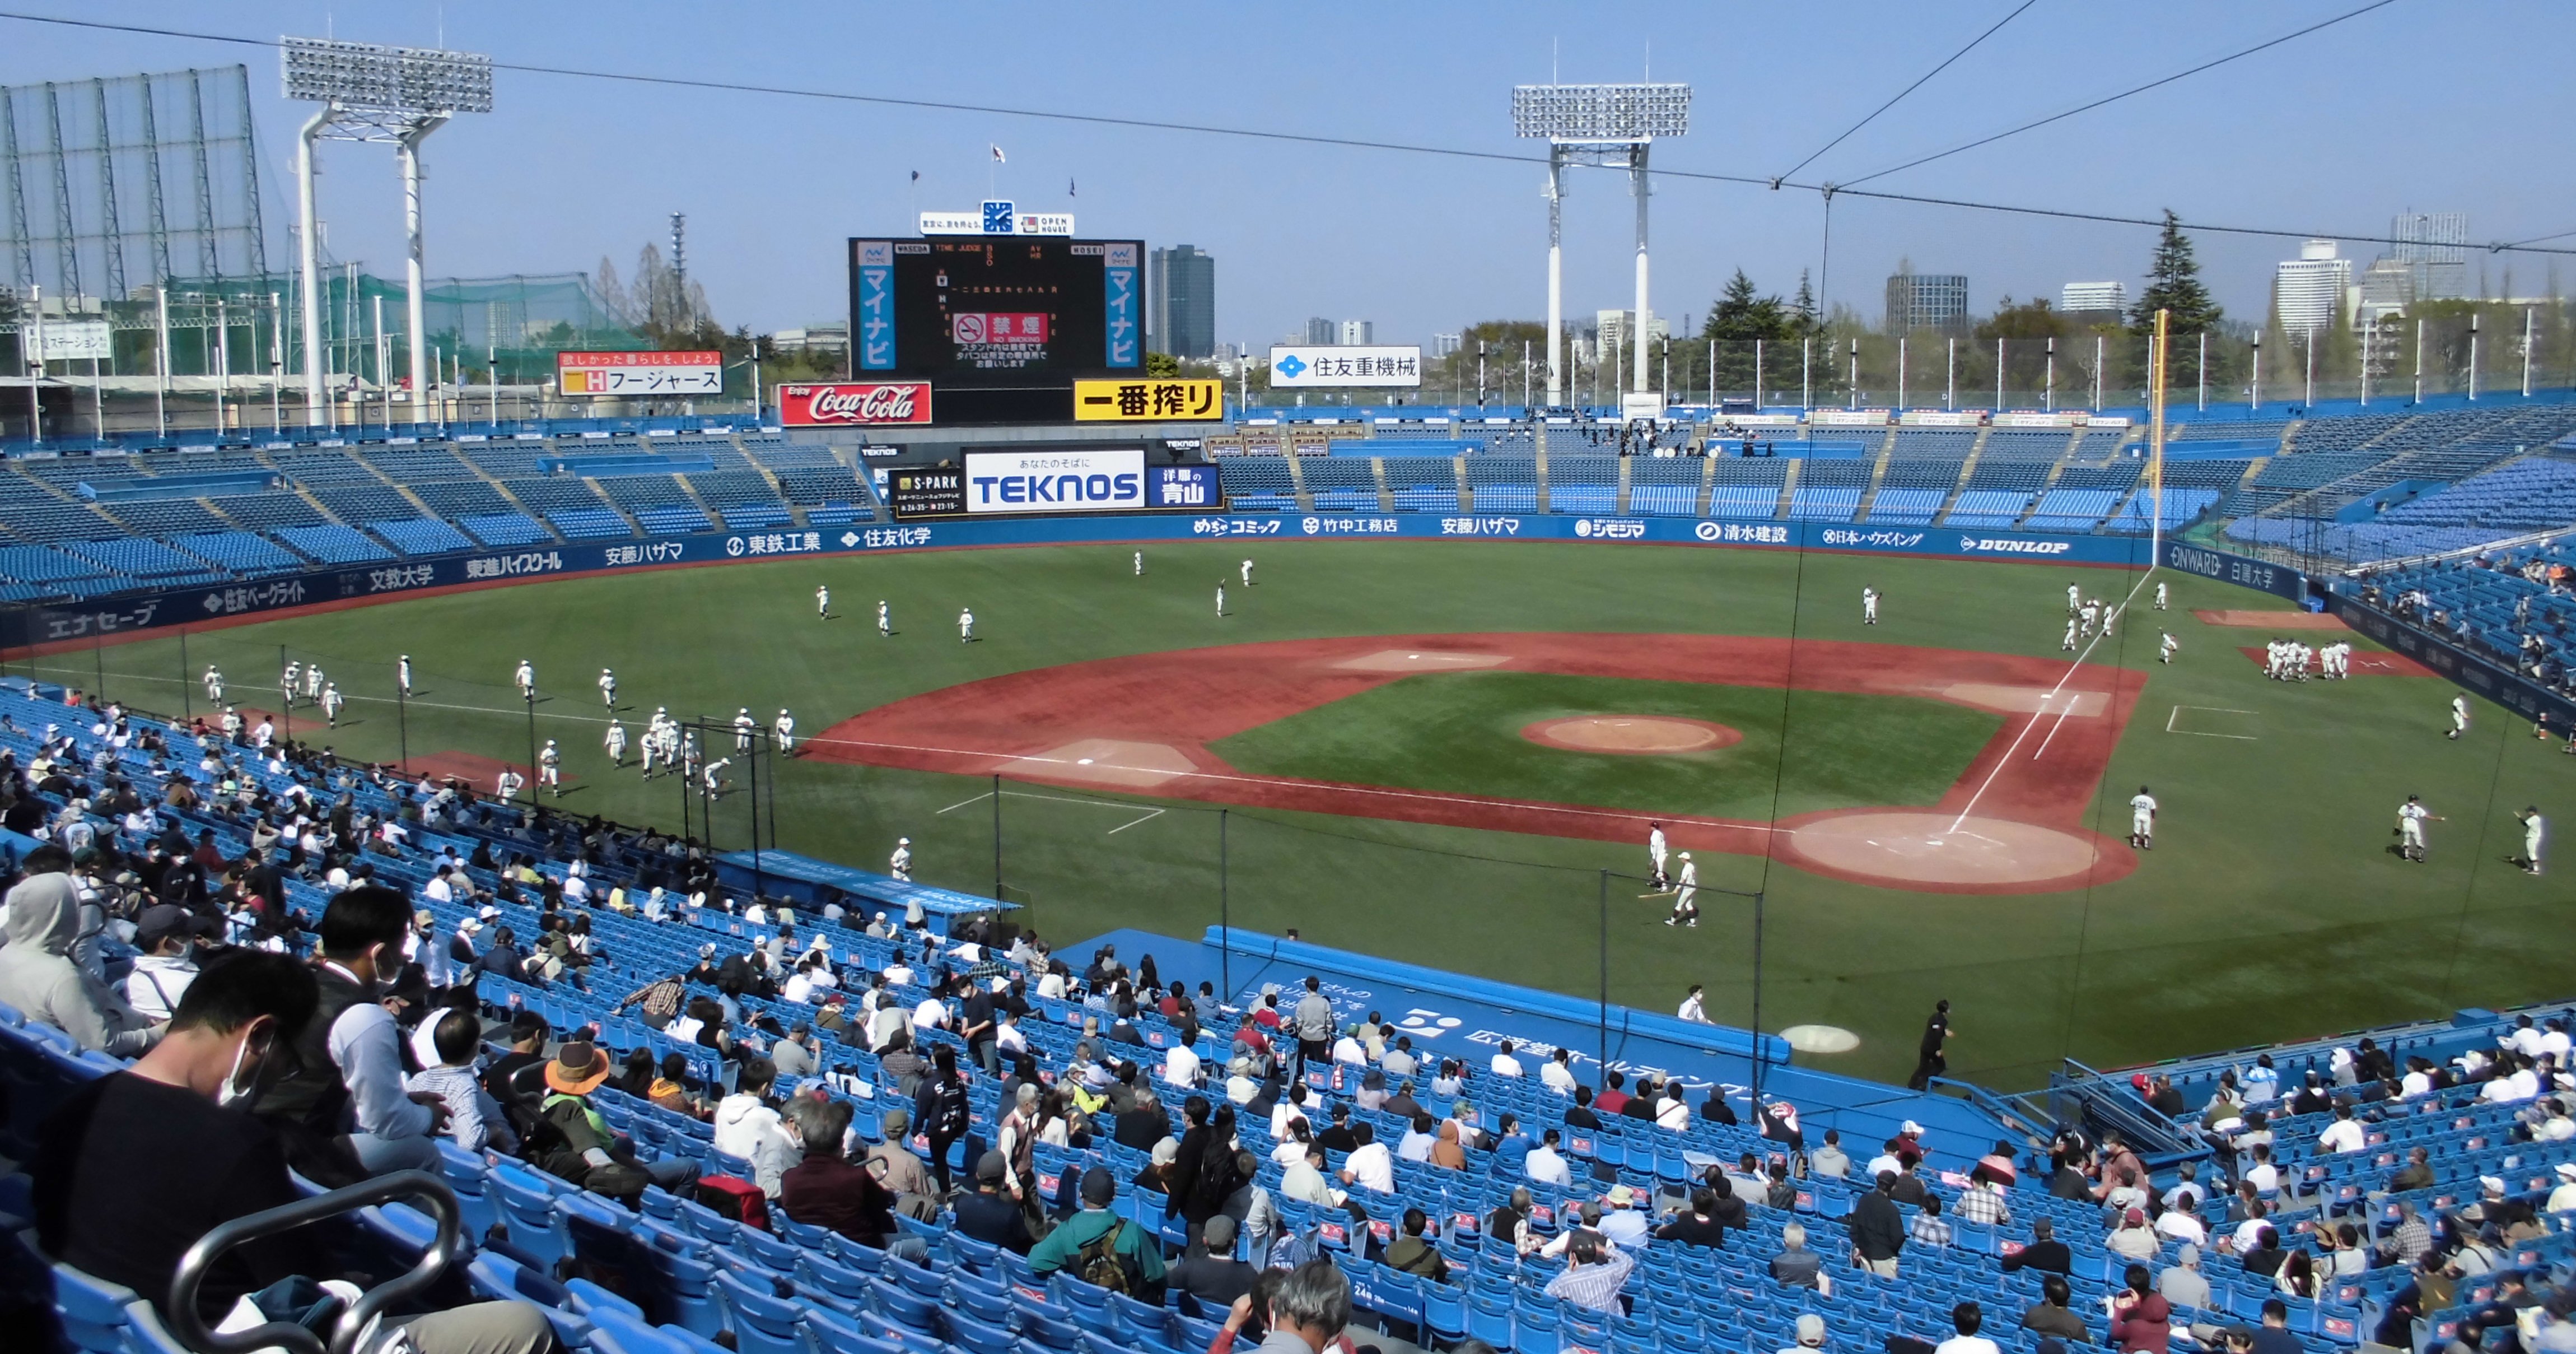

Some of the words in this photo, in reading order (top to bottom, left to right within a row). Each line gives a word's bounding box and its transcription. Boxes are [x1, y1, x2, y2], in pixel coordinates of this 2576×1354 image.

[864, 269, 889, 365] マイナビ
[1110, 271, 1133, 362] マイナビ
[563, 354, 718, 364] 欲しかった暮らしを、しよう。
[1313, 357, 1416, 377] 住友重機械
[610, 370, 717, 389] フージャース
[788, 387, 810, 396] Enjoy
[1084, 384, 1212, 416] 一番搾り
[1020, 459, 1090, 469] あなたのそばに
[914, 476, 958, 490] S-PARK
[1163, 469, 1201, 481] 洋服の
[973, 473, 1138, 504] TEKNOS
[1162, 483, 1204, 504] 青山
[1323, 519, 1397, 533] 竹中工務店
[1441, 518, 1519, 534] 安藤ハザマ
[1593, 524, 1645, 538] シモジマ
[1724, 524, 1787, 543] 清水建設
[749, 532, 822, 554] 東鉄工業
[864, 527, 931, 547] 住友化学
[1836, 531, 1923, 547] 日本ハウズイング
[1977, 538, 2069, 553] DUNLOP
[605, 542, 683, 565] 安藤ハザマ
[2171, 546, 2221, 576] ONWARD
[467, 552, 562, 579] 東進ハイスクール
[370, 564, 434, 592] 文教大学
[225, 580, 305, 612] 住友ベークライト
[49, 604, 156, 638] エナセーブ
